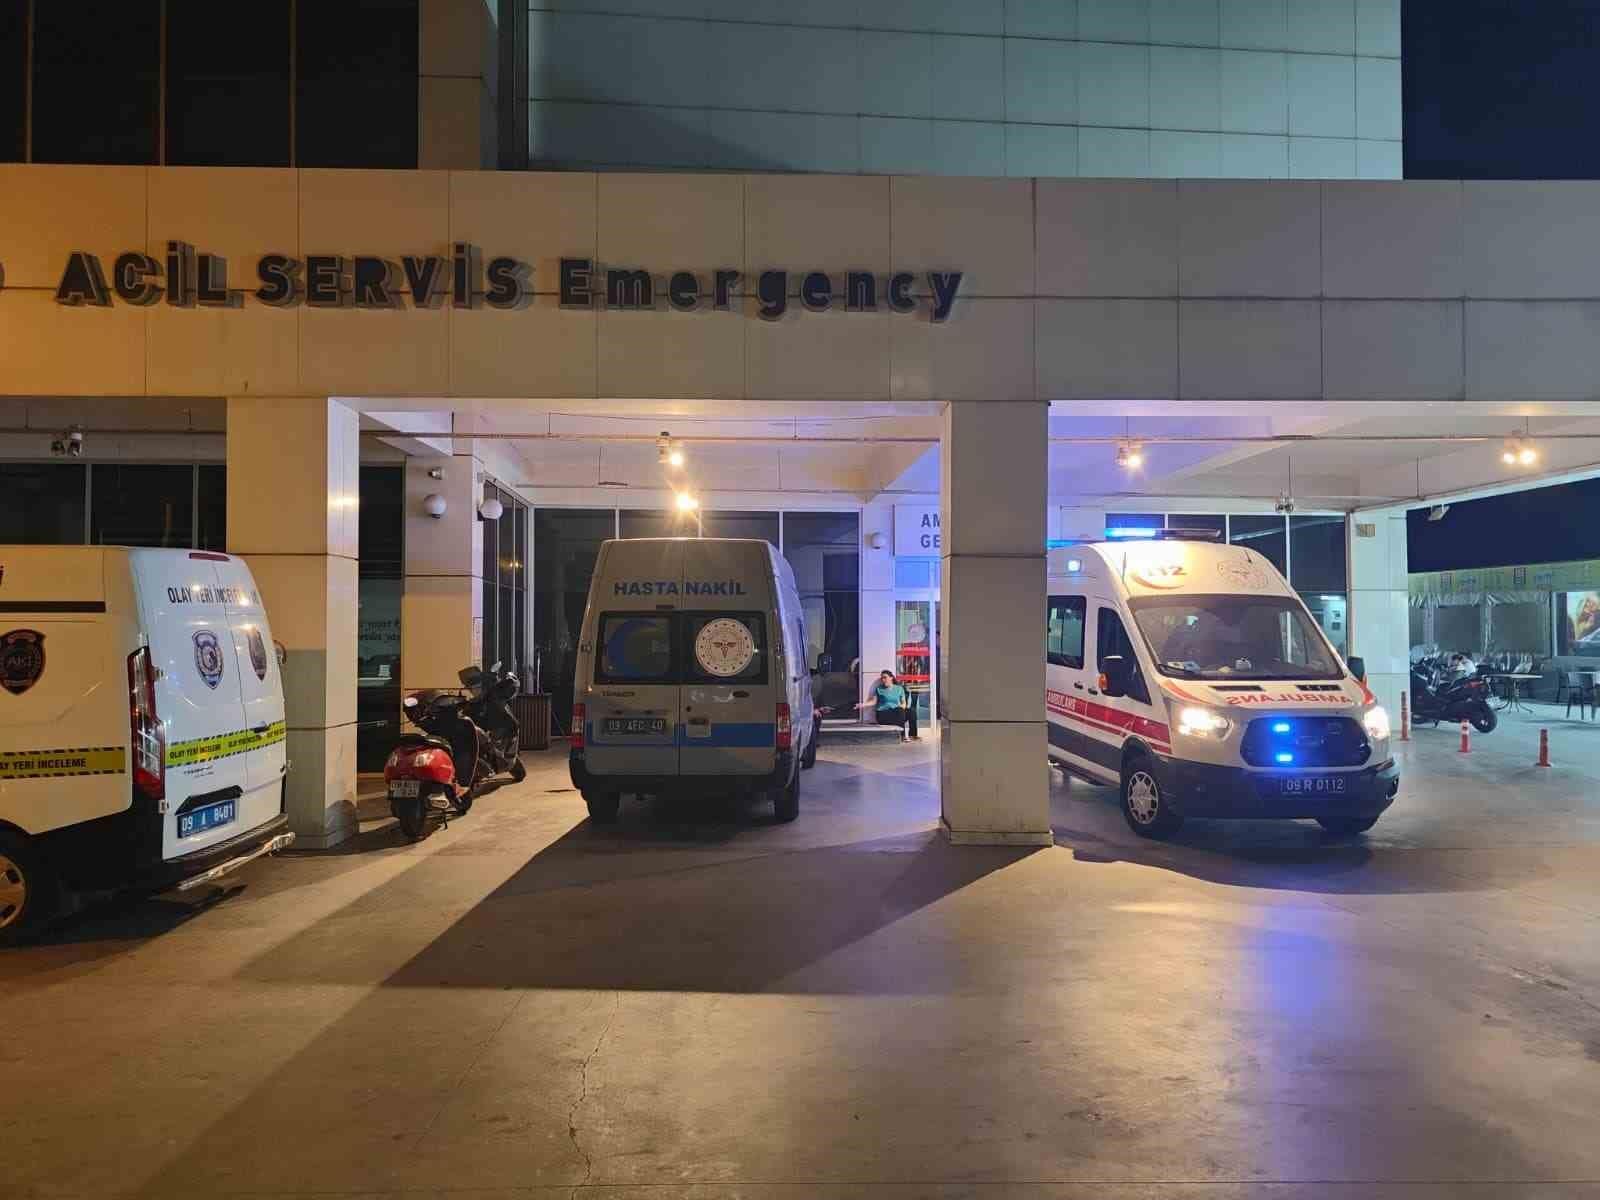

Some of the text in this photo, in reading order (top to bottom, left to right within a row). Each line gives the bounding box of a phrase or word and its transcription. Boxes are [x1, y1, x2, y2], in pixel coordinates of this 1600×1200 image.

[56, 240, 964, 323] ACİL SERVİS Emergency
[167, 587, 193, 604] OLAY
[614, 580, 747, 596] HASTA NAKİL
[1303, 779, 1312, 791] R
[1316, 778, 1344, 791] 0112
